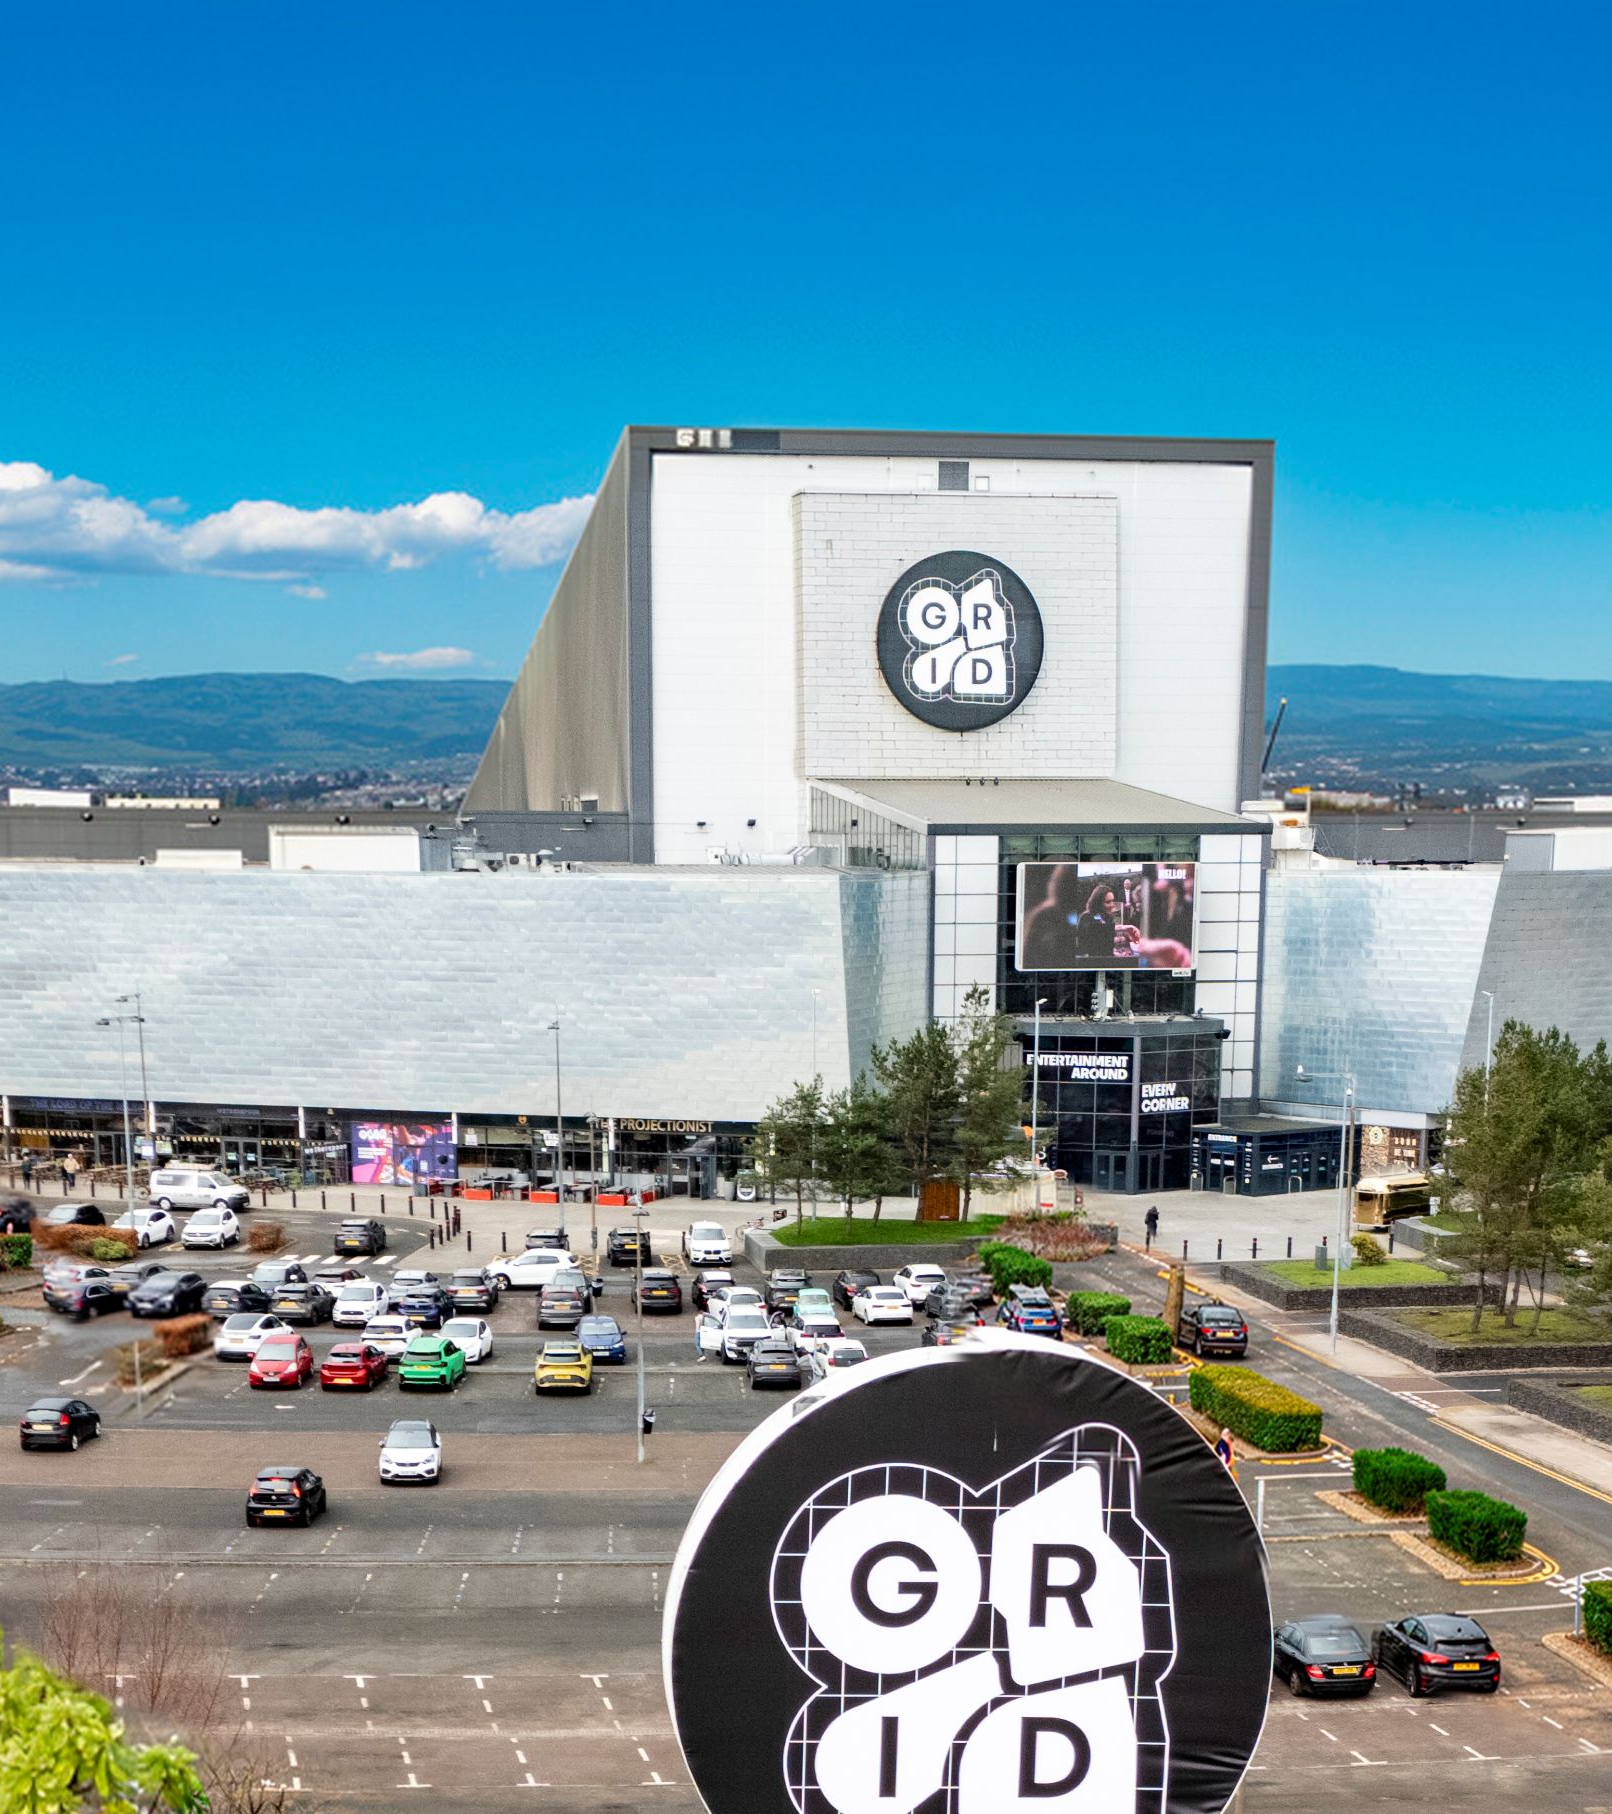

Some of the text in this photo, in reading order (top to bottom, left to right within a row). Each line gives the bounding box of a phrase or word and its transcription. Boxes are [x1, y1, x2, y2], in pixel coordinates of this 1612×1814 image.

[1158, 869, 1186, 880] HELLO!
[1026, 1053, 1129, 1067] ENTERTAINMENT
[1070, 1068, 1129, 1081] AROUND
[1141, 1083, 1177, 1098] EVERY
[1140, 1097, 1190, 1113] CORNER
[620, 1119, 714, 1133] PROJECTIONIST
